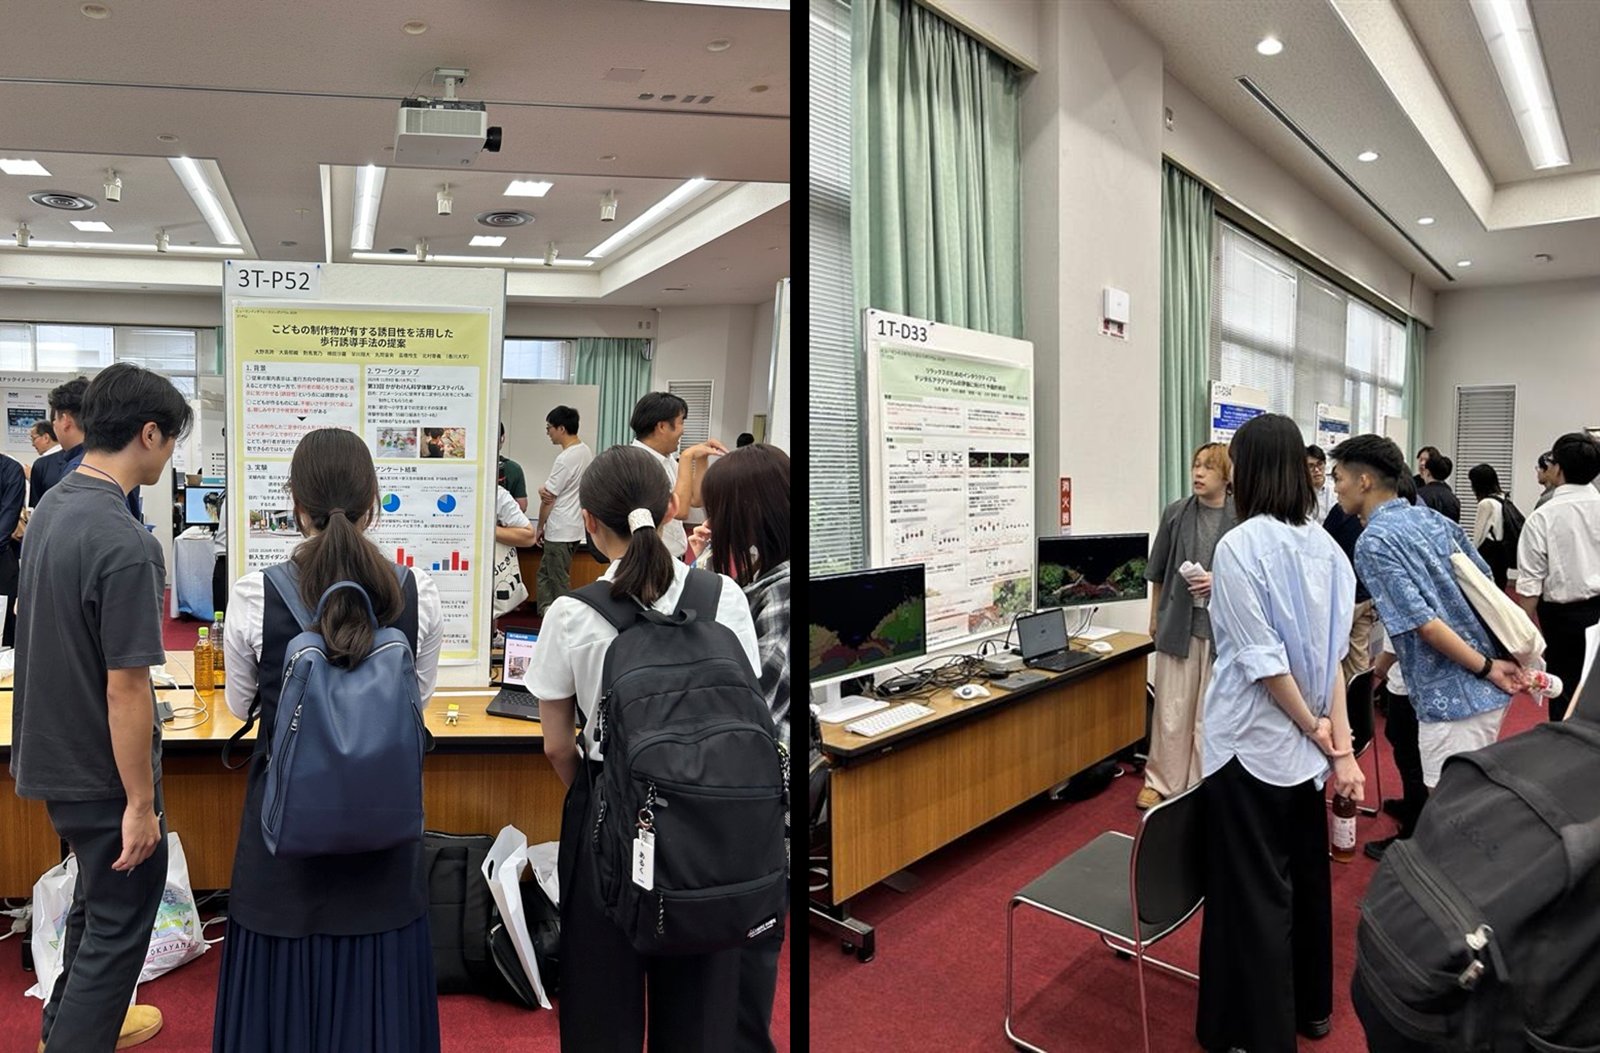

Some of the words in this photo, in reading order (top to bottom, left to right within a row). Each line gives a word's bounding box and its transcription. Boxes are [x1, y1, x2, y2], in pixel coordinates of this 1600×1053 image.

[238, 269, 310, 291] 3T-P52
[272, 325, 453, 338] こどもの制作物が有する誘目性を活用した
[877, 319, 928, 343] 1T-D33
[320, 337, 406, 348] 歩行誘導手法の提案
[385, 383, 466, 392] かがわけん科学体験フェスティバル
[248, 553, 289, 561] 新入生ガイダンス
[150, 942, 192, 956] OKAYAMA
